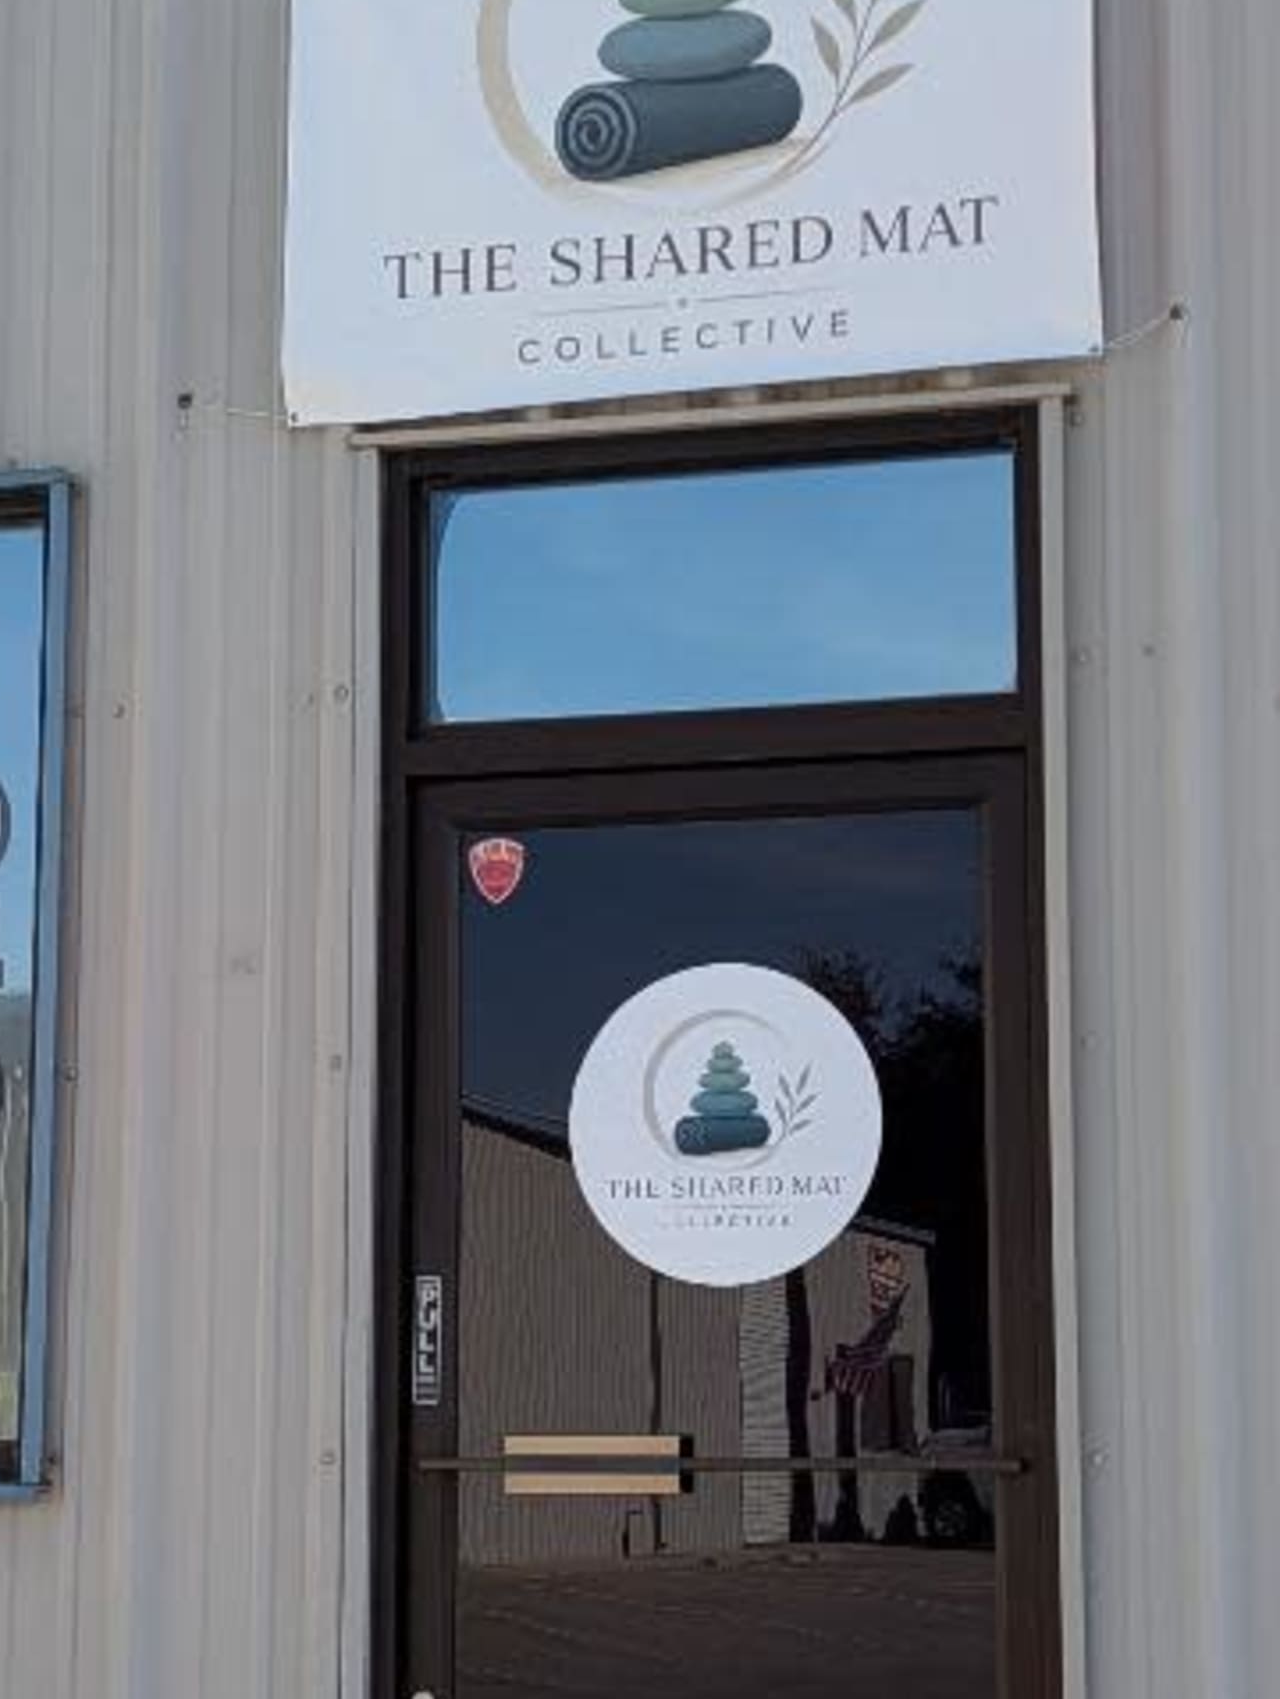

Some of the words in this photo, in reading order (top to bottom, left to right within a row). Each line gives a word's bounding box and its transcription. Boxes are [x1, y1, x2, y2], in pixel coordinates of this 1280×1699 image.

[384, 243, 519, 299] THE
[549, 215, 834, 288] SHARED
[858, 196, 999, 258] MAT
[517, 310, 851, 365] COLLECTIVE
[670, 1175, 784, 1198] SHARED
